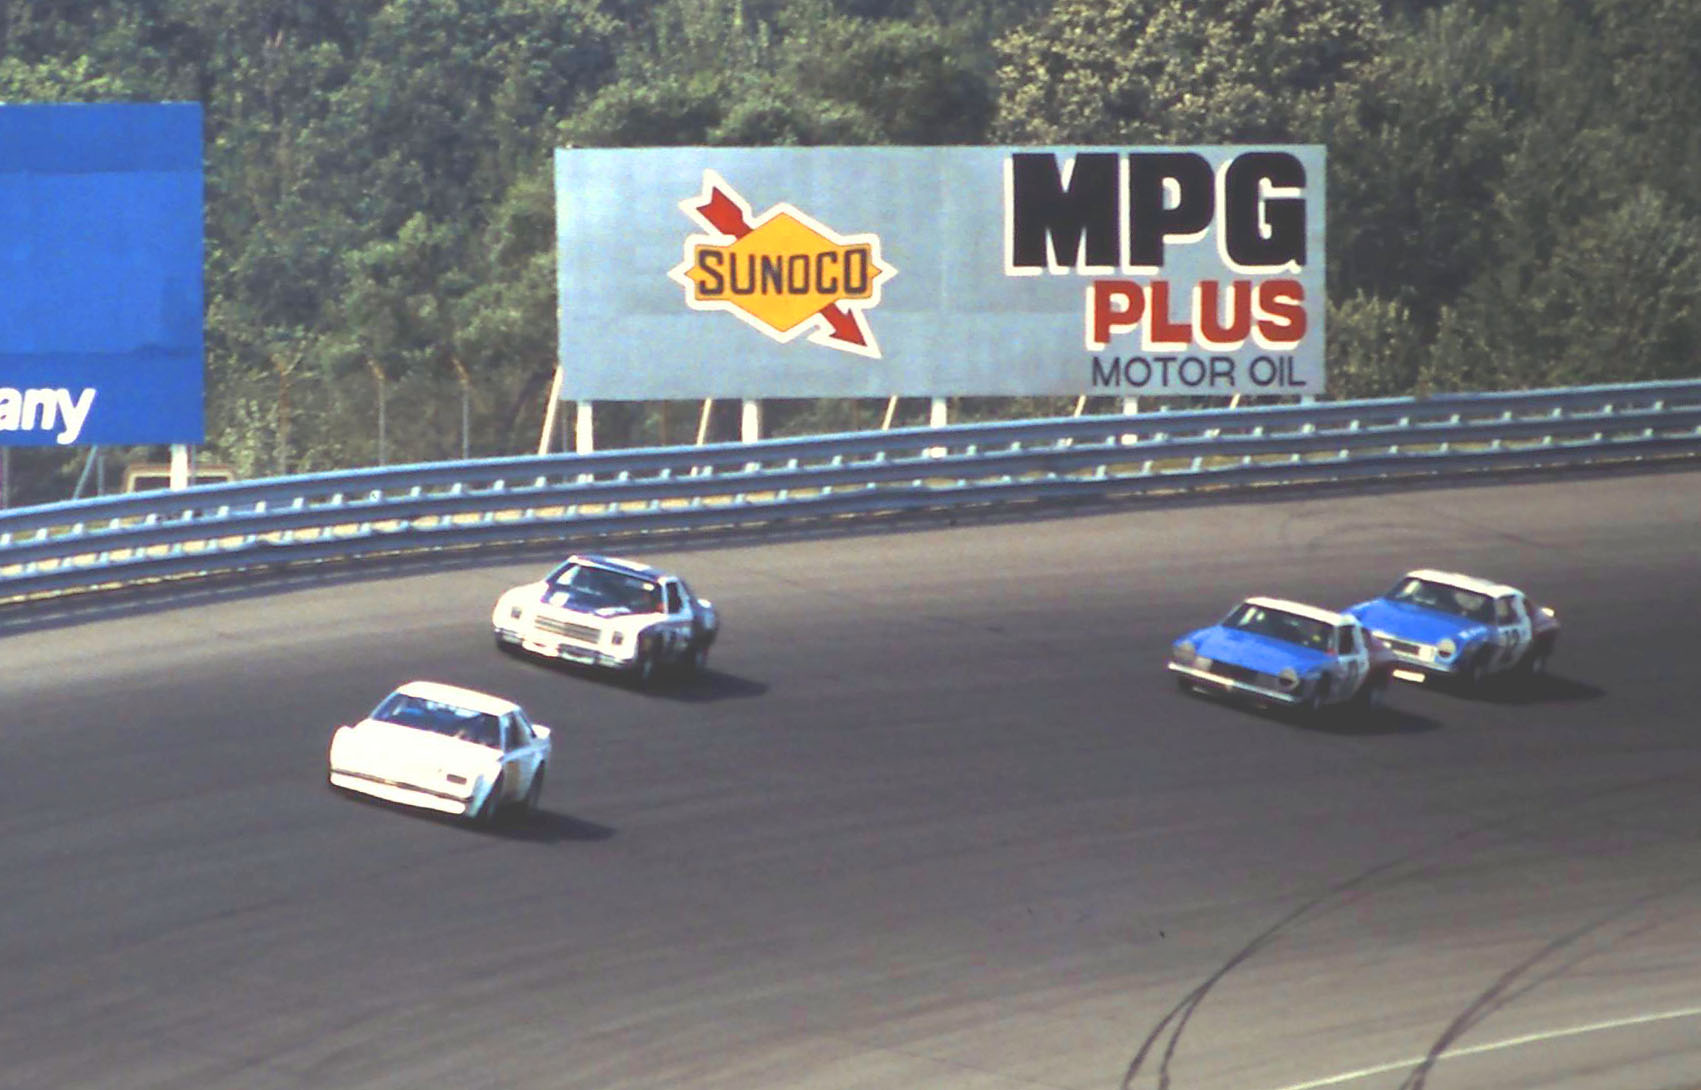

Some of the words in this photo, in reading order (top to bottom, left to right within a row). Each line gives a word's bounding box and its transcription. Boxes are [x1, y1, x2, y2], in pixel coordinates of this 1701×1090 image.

[1006, 152, 1307, 274] MPG
[698, 248, 868, 296] SUNOCO
[1087, 280, 1308, 351] PLUS
[1091, 356, 1236, 388] MOTOR
[1248, 356, 1307, 387] OIL
